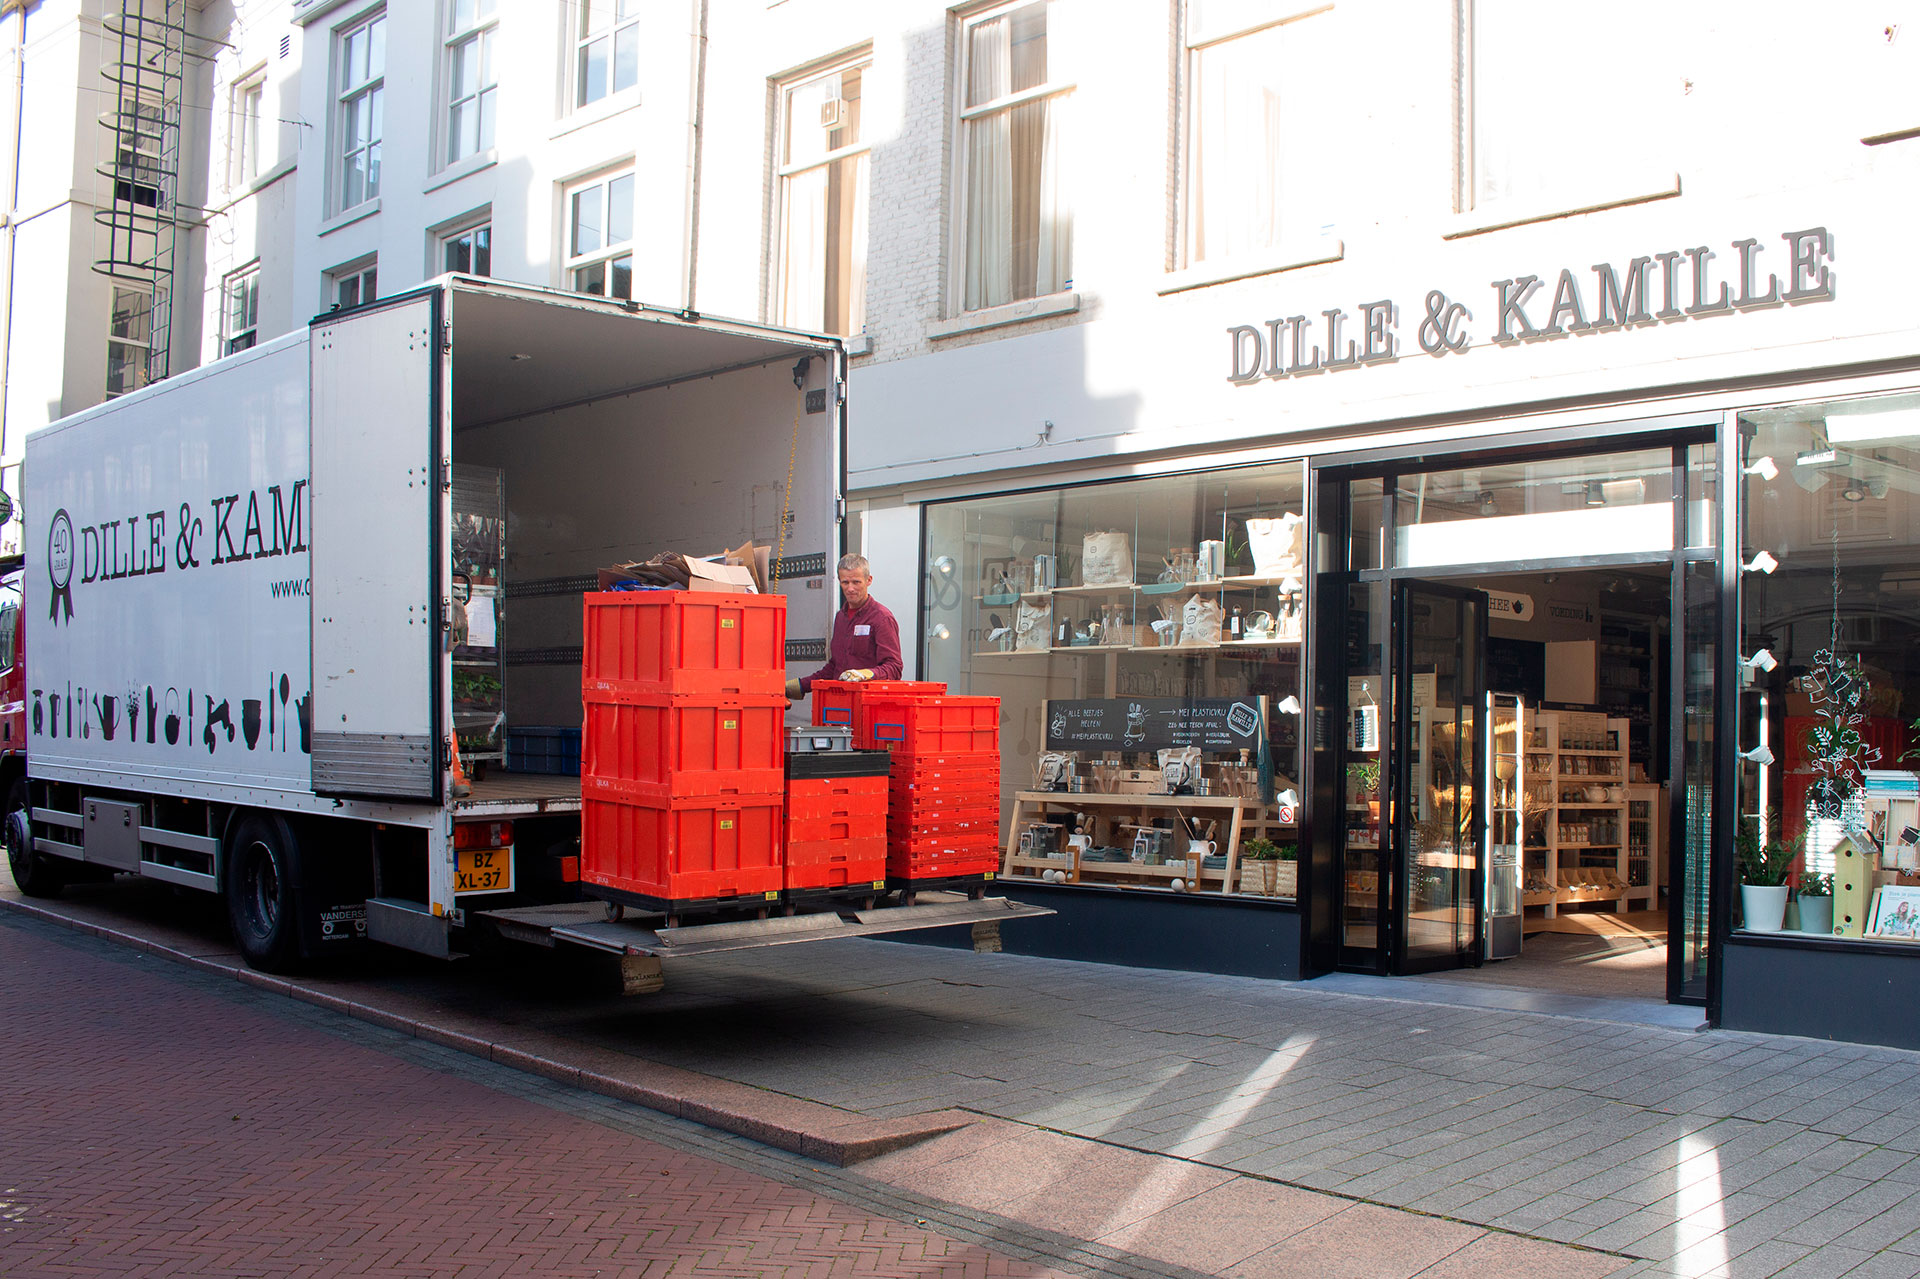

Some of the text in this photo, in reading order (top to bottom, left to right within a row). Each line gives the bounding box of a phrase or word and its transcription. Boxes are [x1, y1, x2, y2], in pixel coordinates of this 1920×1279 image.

[1226, 227, 1832, 384] DILLE & KAMILLE
[81, 478, 310, 584] DILLE & KAM
[54, 528, 68, 554] 40
[1489, 597, 1509, 611] HEE
[1068, 709, 1104, 717] ALLE BEETJES
[1178, 708, 1189, 717] MEI
[1080, 719, 1101, 728] HELPEN
[474, 852, 493, 868] BZ
[458, 871, 502, 889] XL-37
